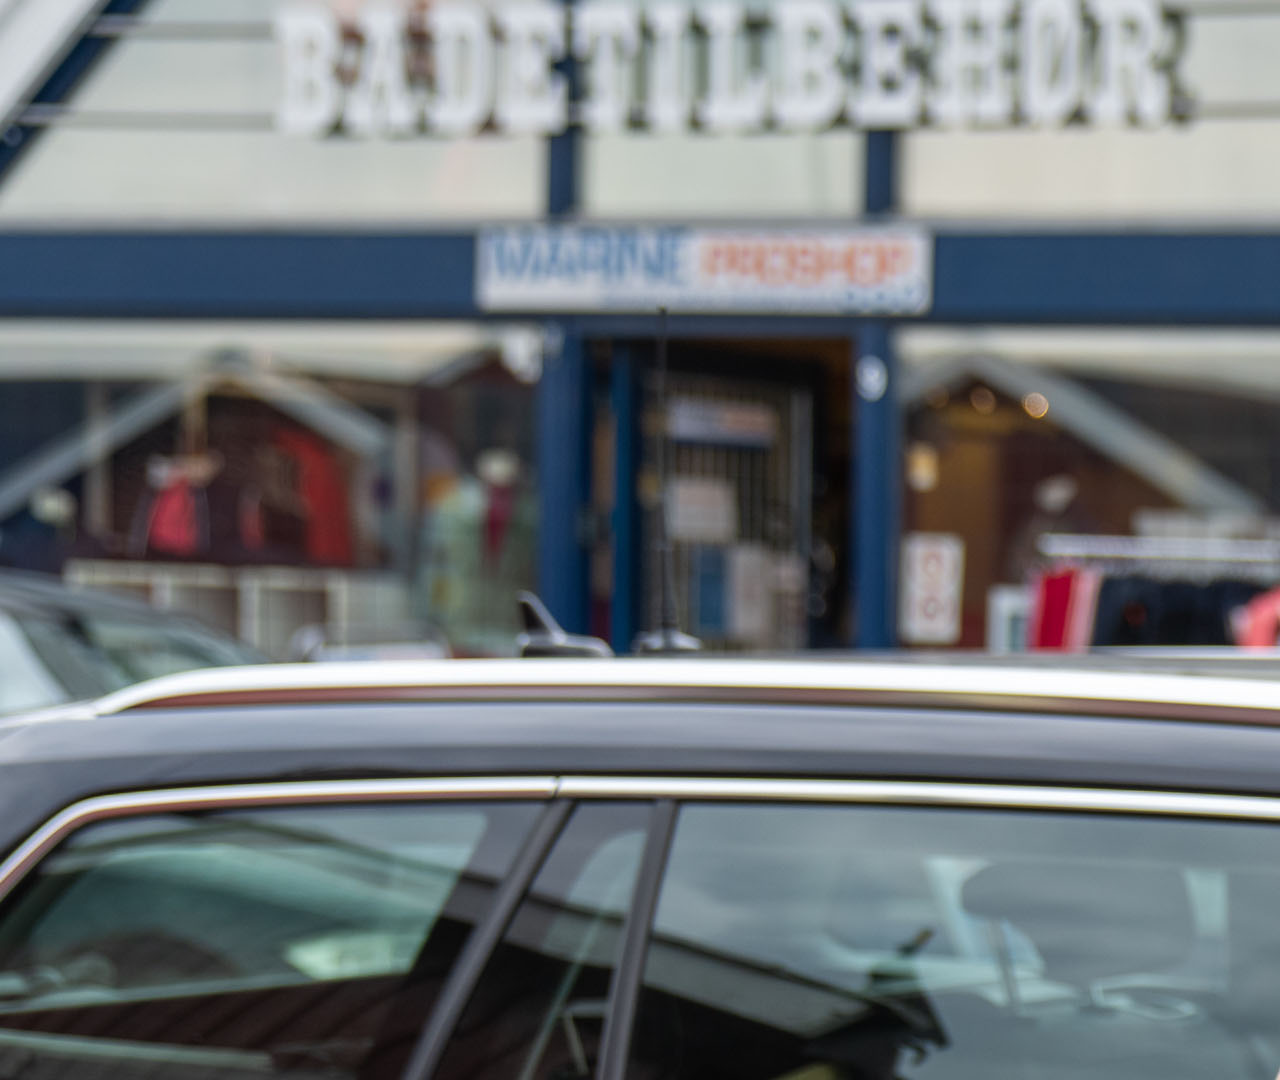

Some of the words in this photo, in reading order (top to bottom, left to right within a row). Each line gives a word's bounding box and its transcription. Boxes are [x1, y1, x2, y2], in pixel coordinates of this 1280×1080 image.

[276, 0, 1182, 134] BADETILBEHØR
[494, 226, 690, 285] MARINE
[706, 236, 914, 286] PROSHOP
